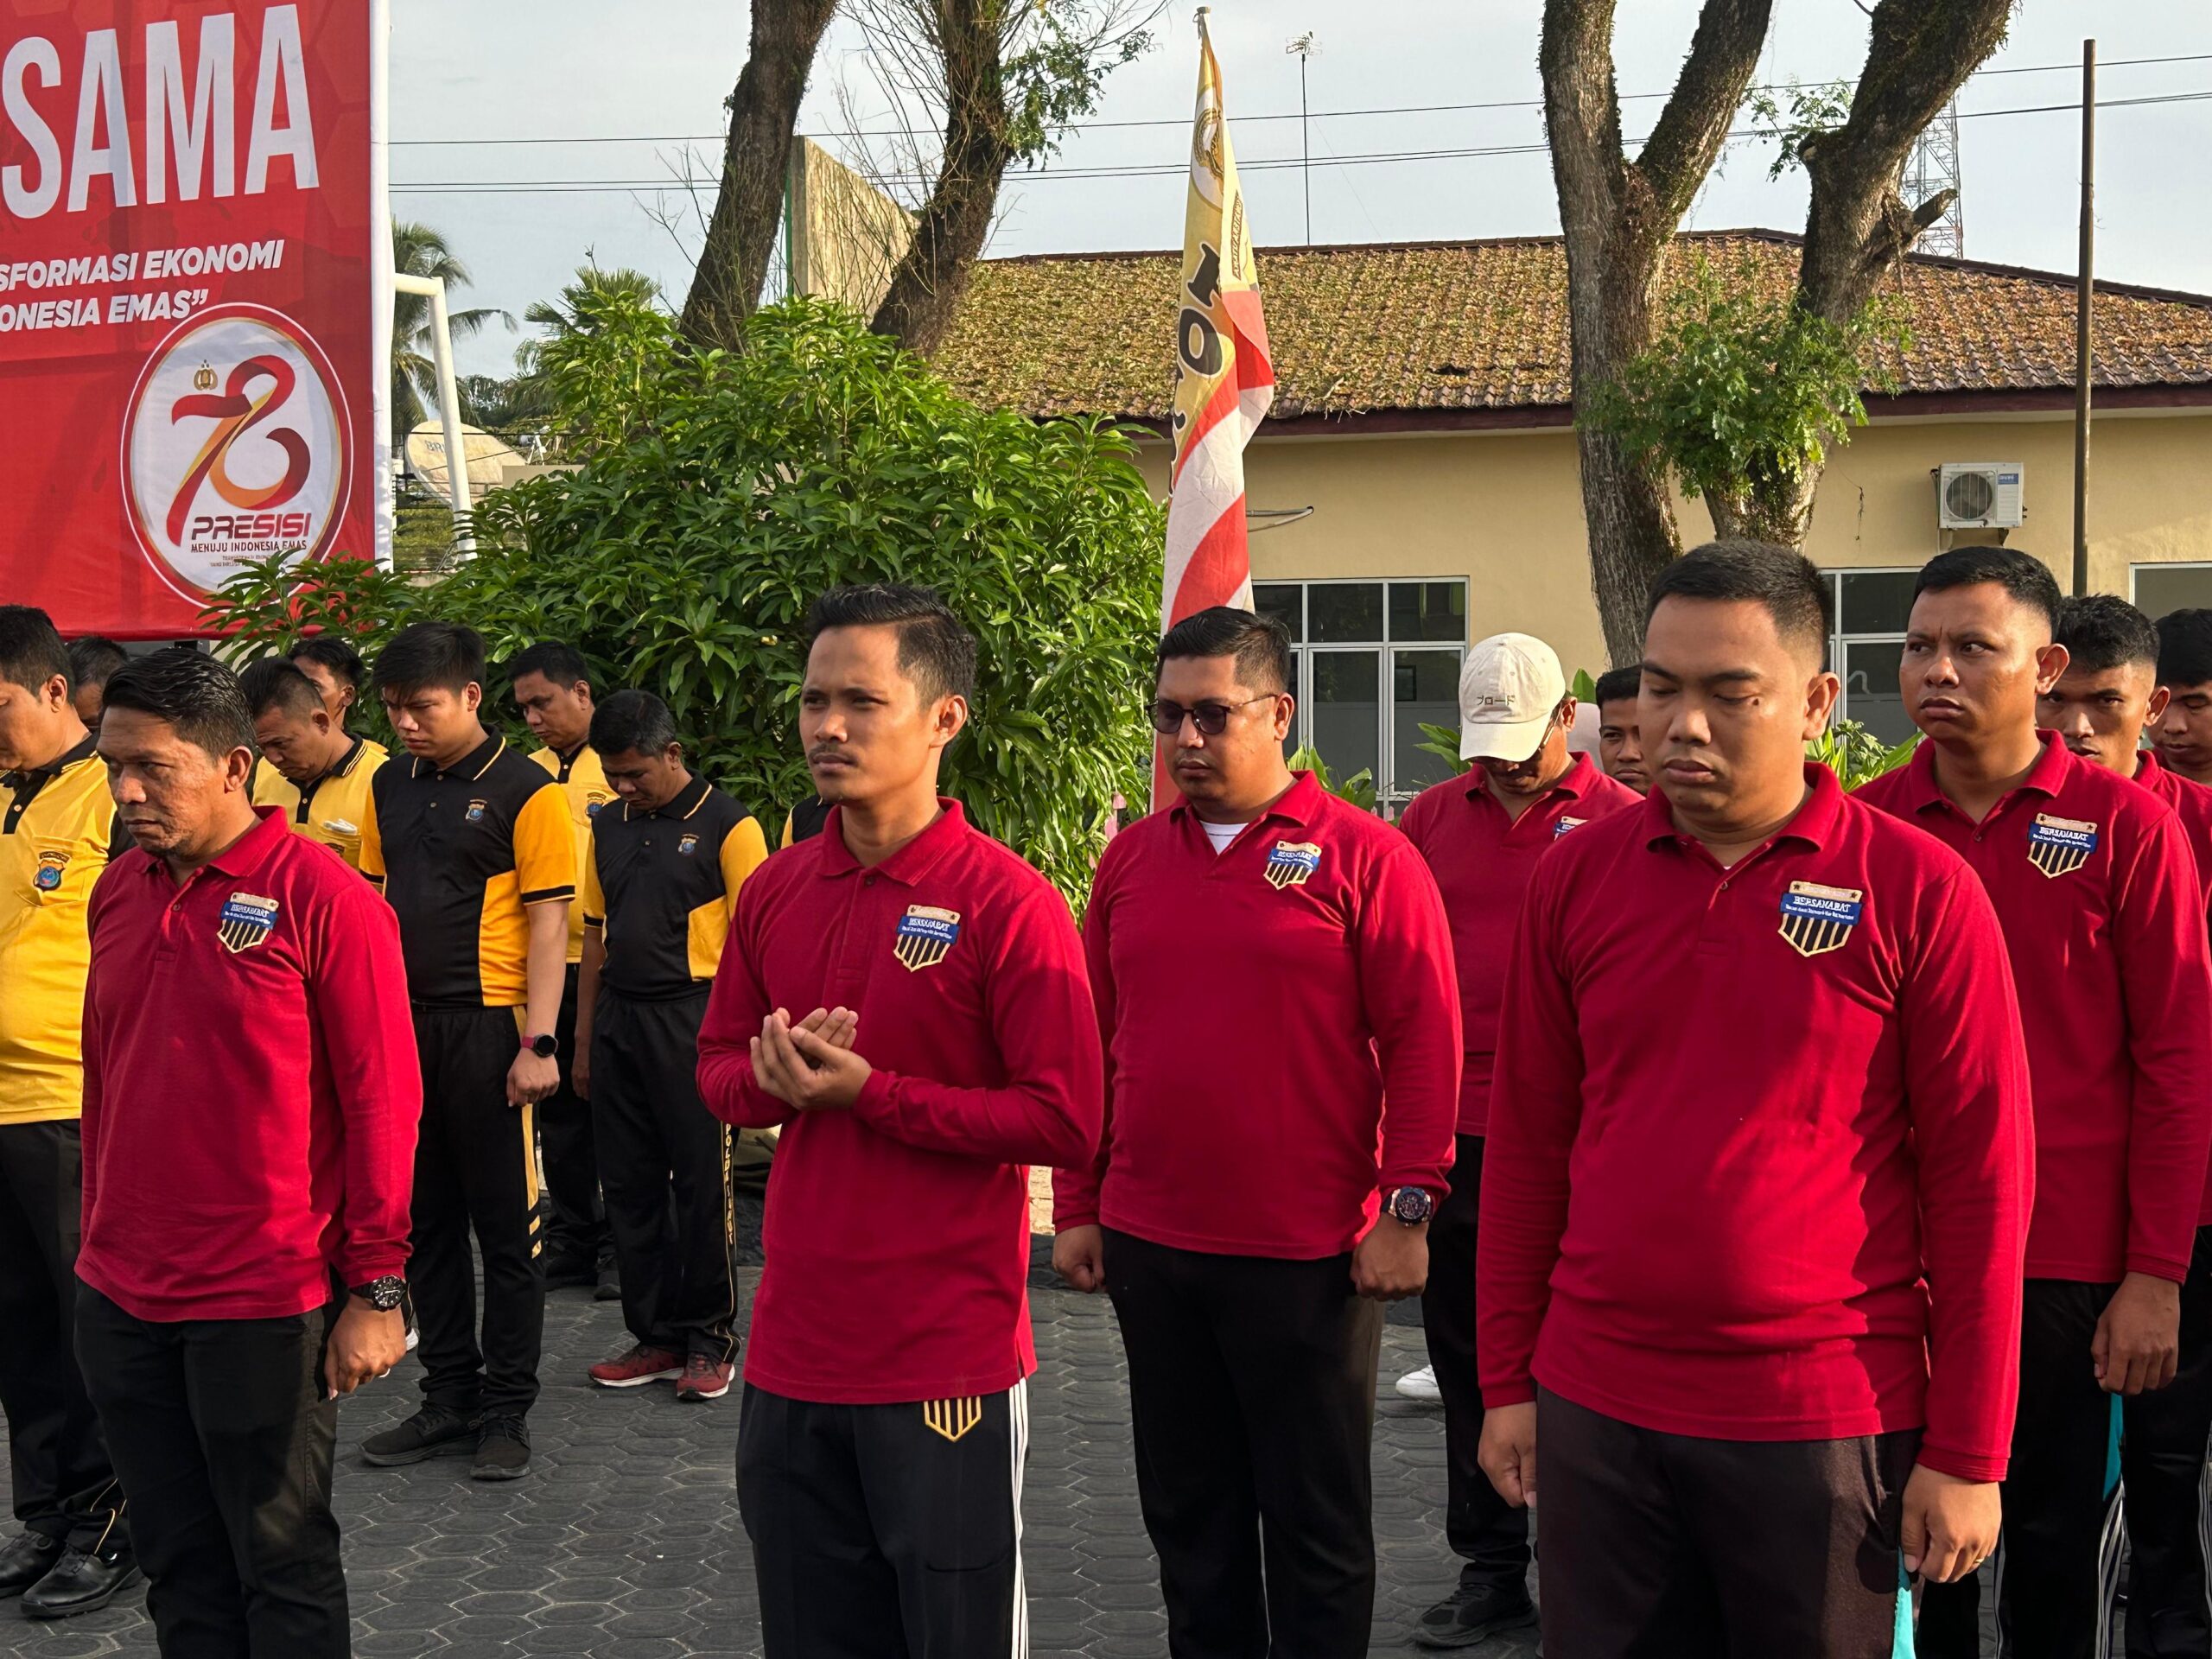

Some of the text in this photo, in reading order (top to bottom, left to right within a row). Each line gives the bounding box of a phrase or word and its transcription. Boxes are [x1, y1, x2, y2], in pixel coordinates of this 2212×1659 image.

[2, 3, 319, 219] SAMA
[143, 239, 284, 280] EKONOMI
[0, 297, 100, 332] ONESIA
[192, 513, 312, 540] PRESISI
[191, 542, 227, 553] MENUJU
[231, 541, 280, 552] INDONESIA
